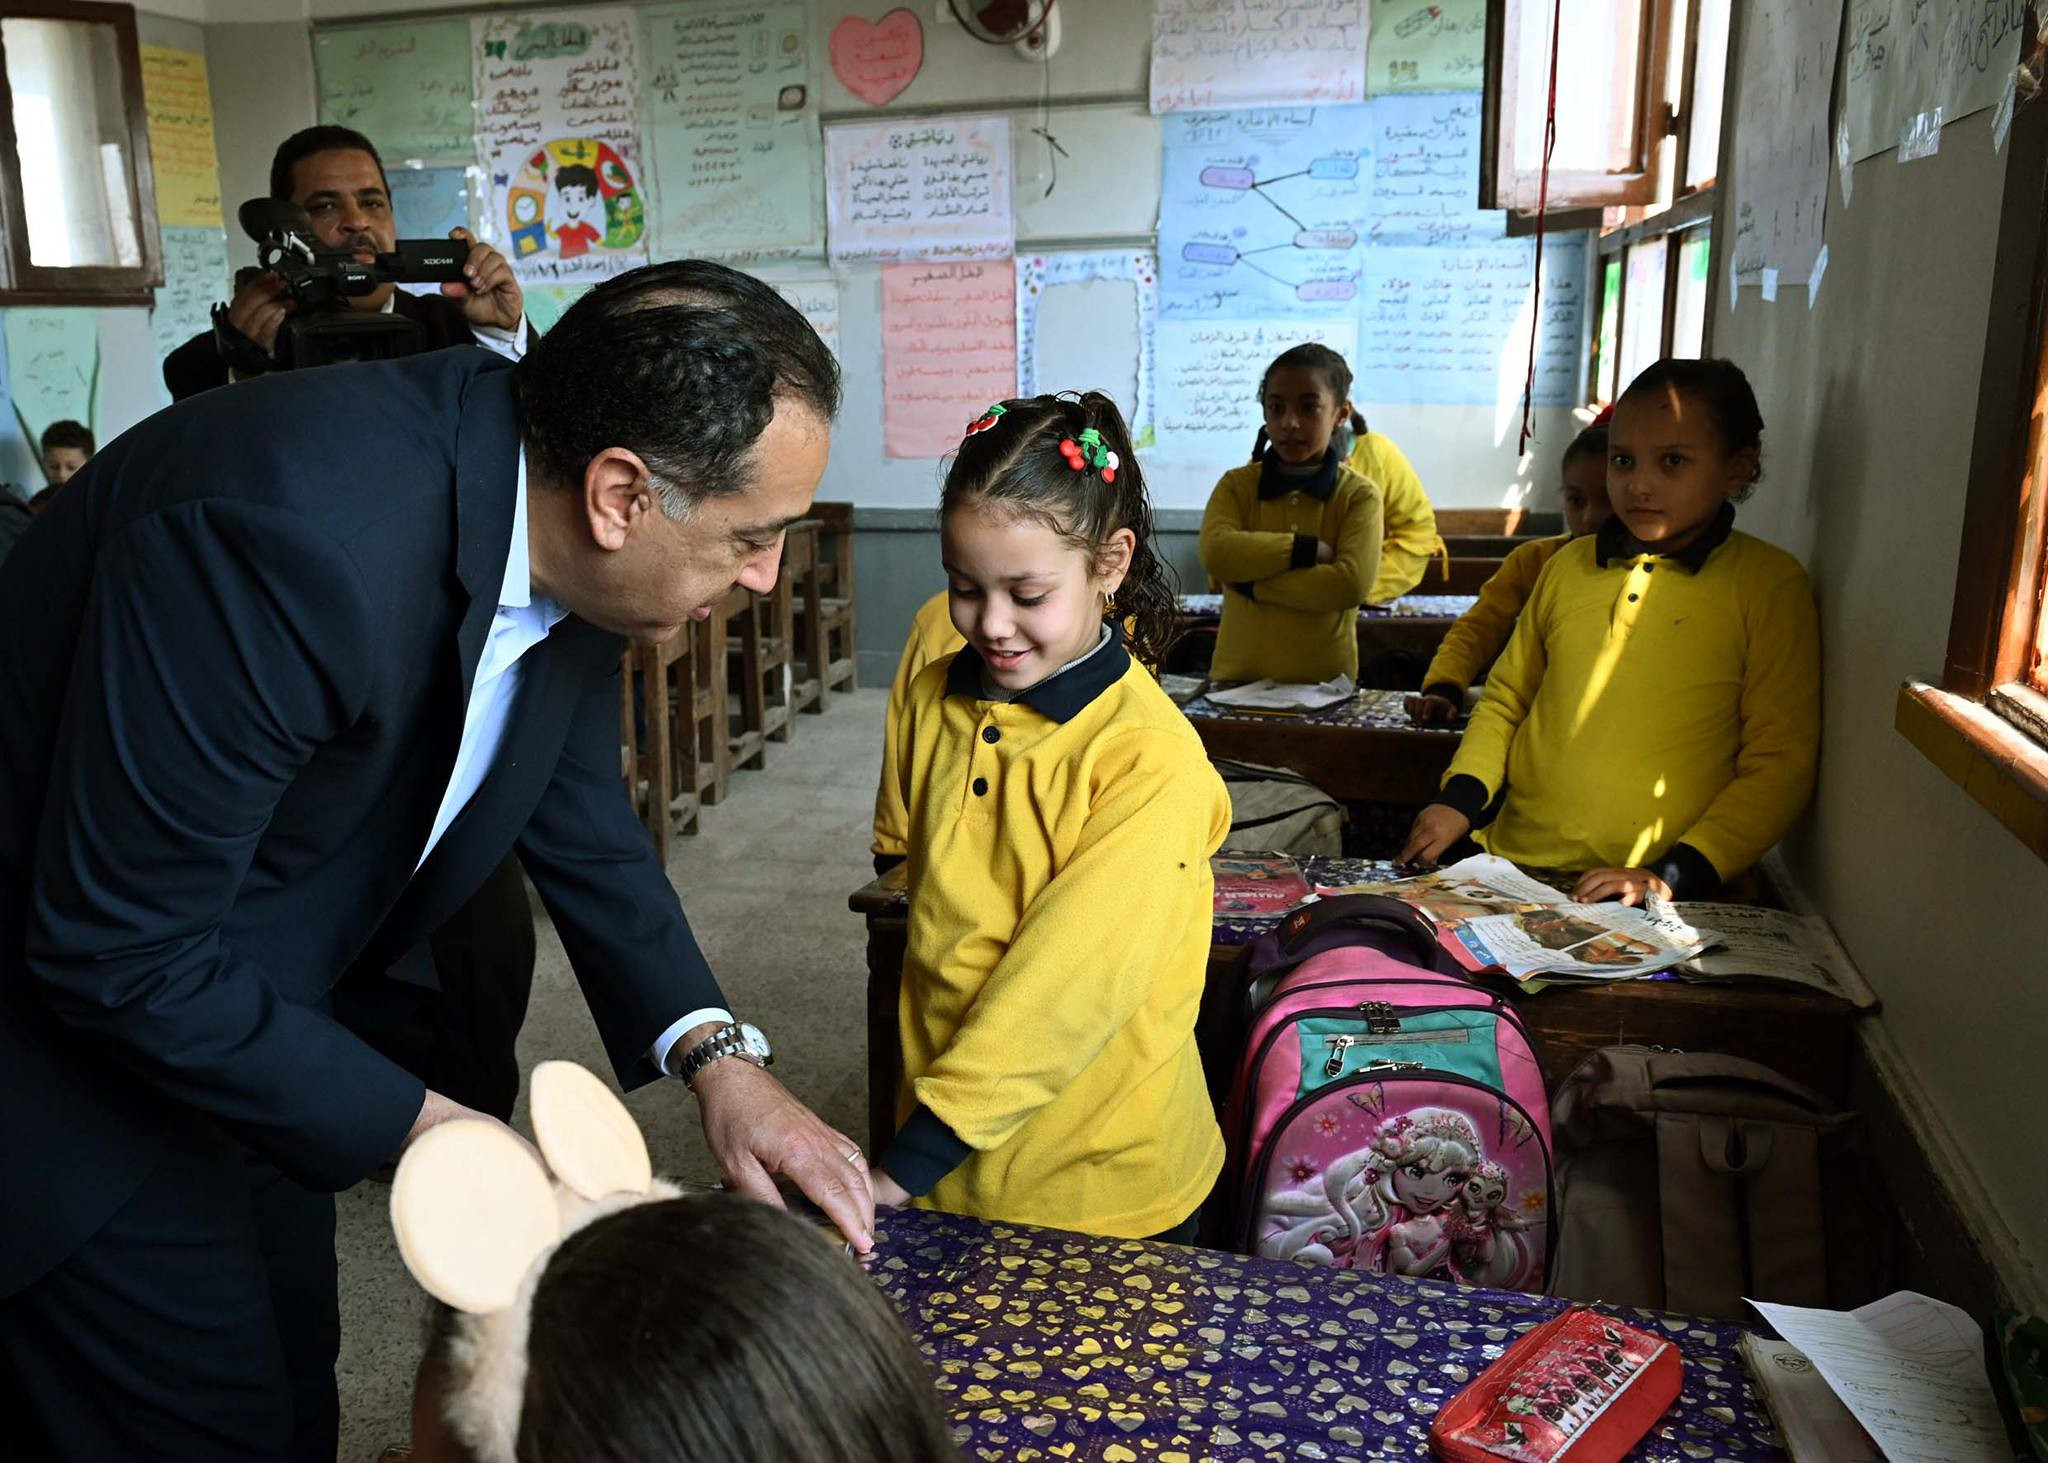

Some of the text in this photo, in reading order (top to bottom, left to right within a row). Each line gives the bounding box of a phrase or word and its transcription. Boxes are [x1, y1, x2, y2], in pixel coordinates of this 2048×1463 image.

[905, 129, 955, 149] رياضتي
[923, 152, 960, 167] الجديدة
[960, 152, 989, 168] رياضتي
